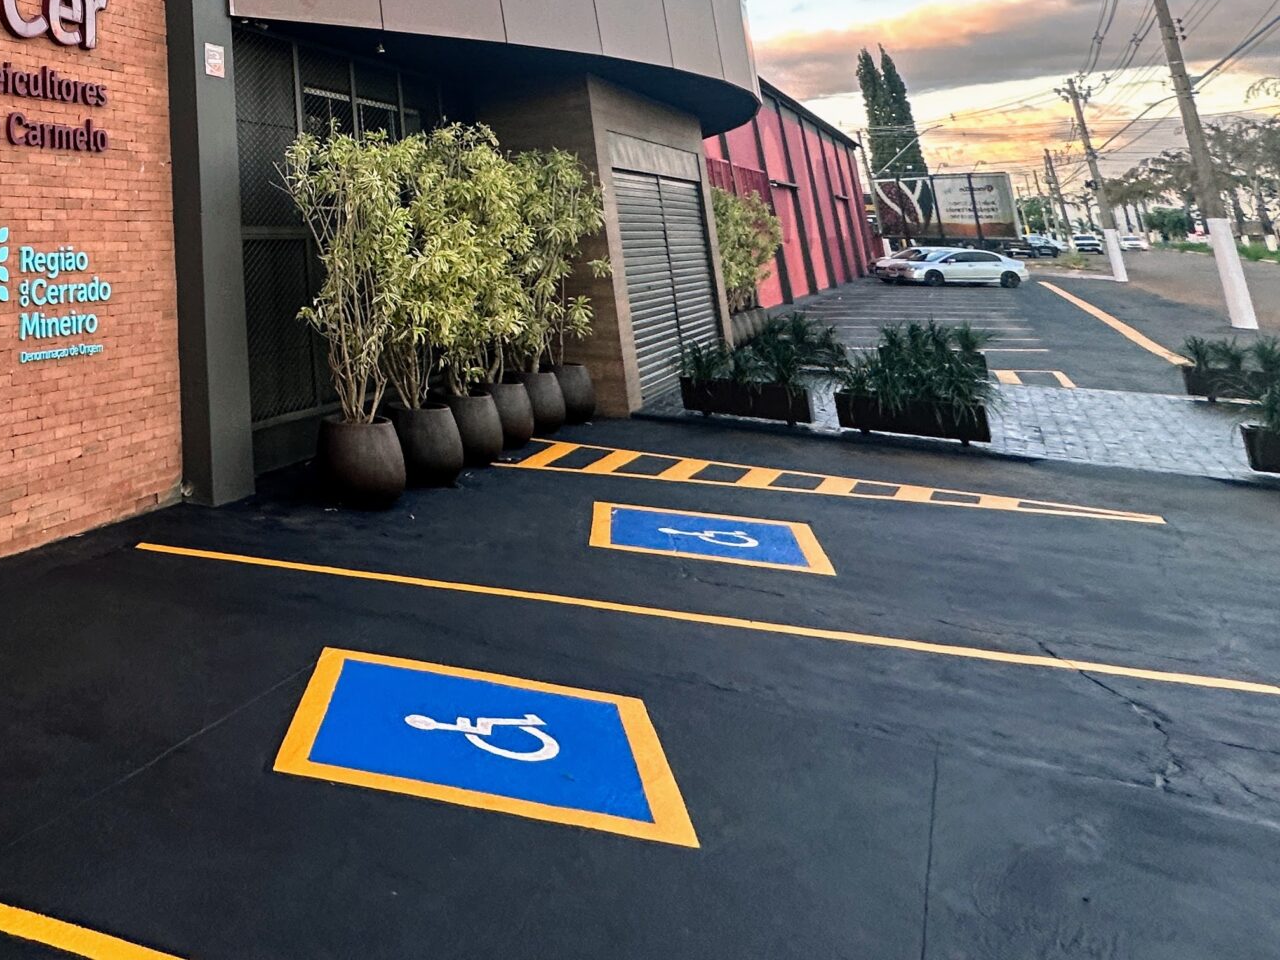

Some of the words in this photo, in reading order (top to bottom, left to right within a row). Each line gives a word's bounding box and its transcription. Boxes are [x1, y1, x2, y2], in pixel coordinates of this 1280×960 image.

[6, 112, 109, 153] Carmelo
[20, 246, 89, 279] Região
[31, 276, 112, 306] Cerrado
[20, 310, 98, 340] Mineiro
